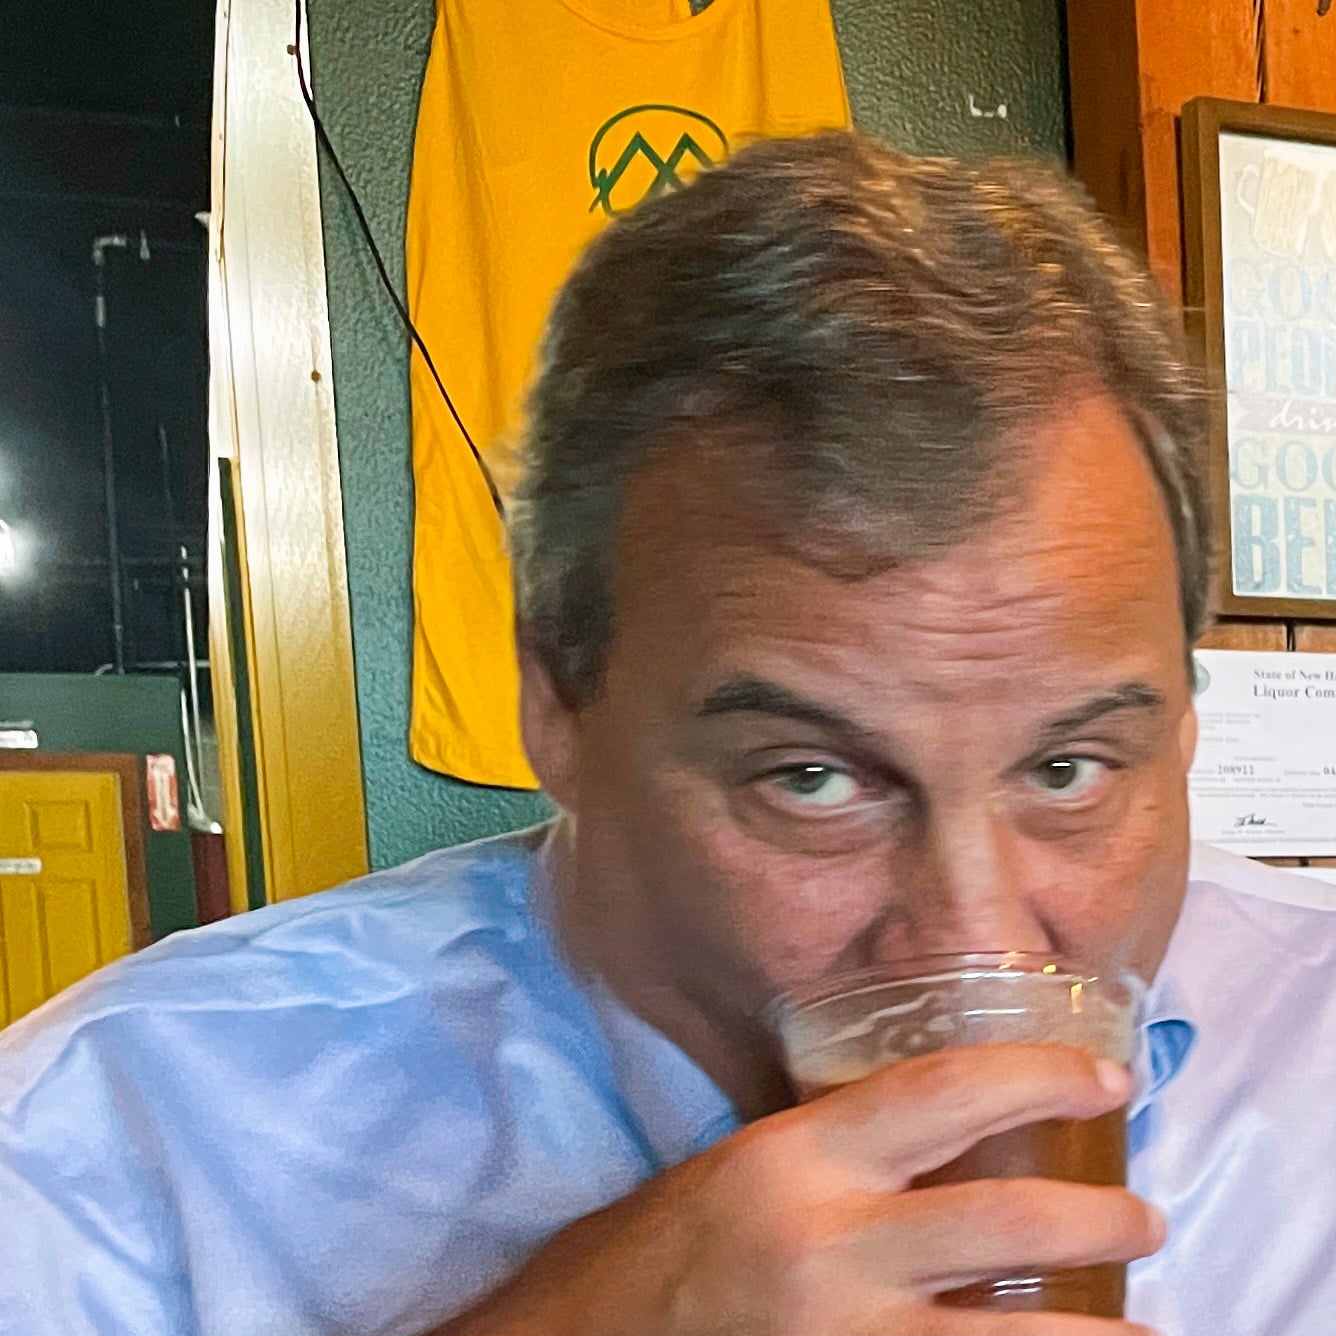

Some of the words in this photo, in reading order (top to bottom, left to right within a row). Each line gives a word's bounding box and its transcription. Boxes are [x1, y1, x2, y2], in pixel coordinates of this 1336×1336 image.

[1253, 670, 1282, 681] State
[1285, 670, 1296, 681] of
[1299, 670, 1322, 682] New
[1252, 684, 1300, 700] Liquor
